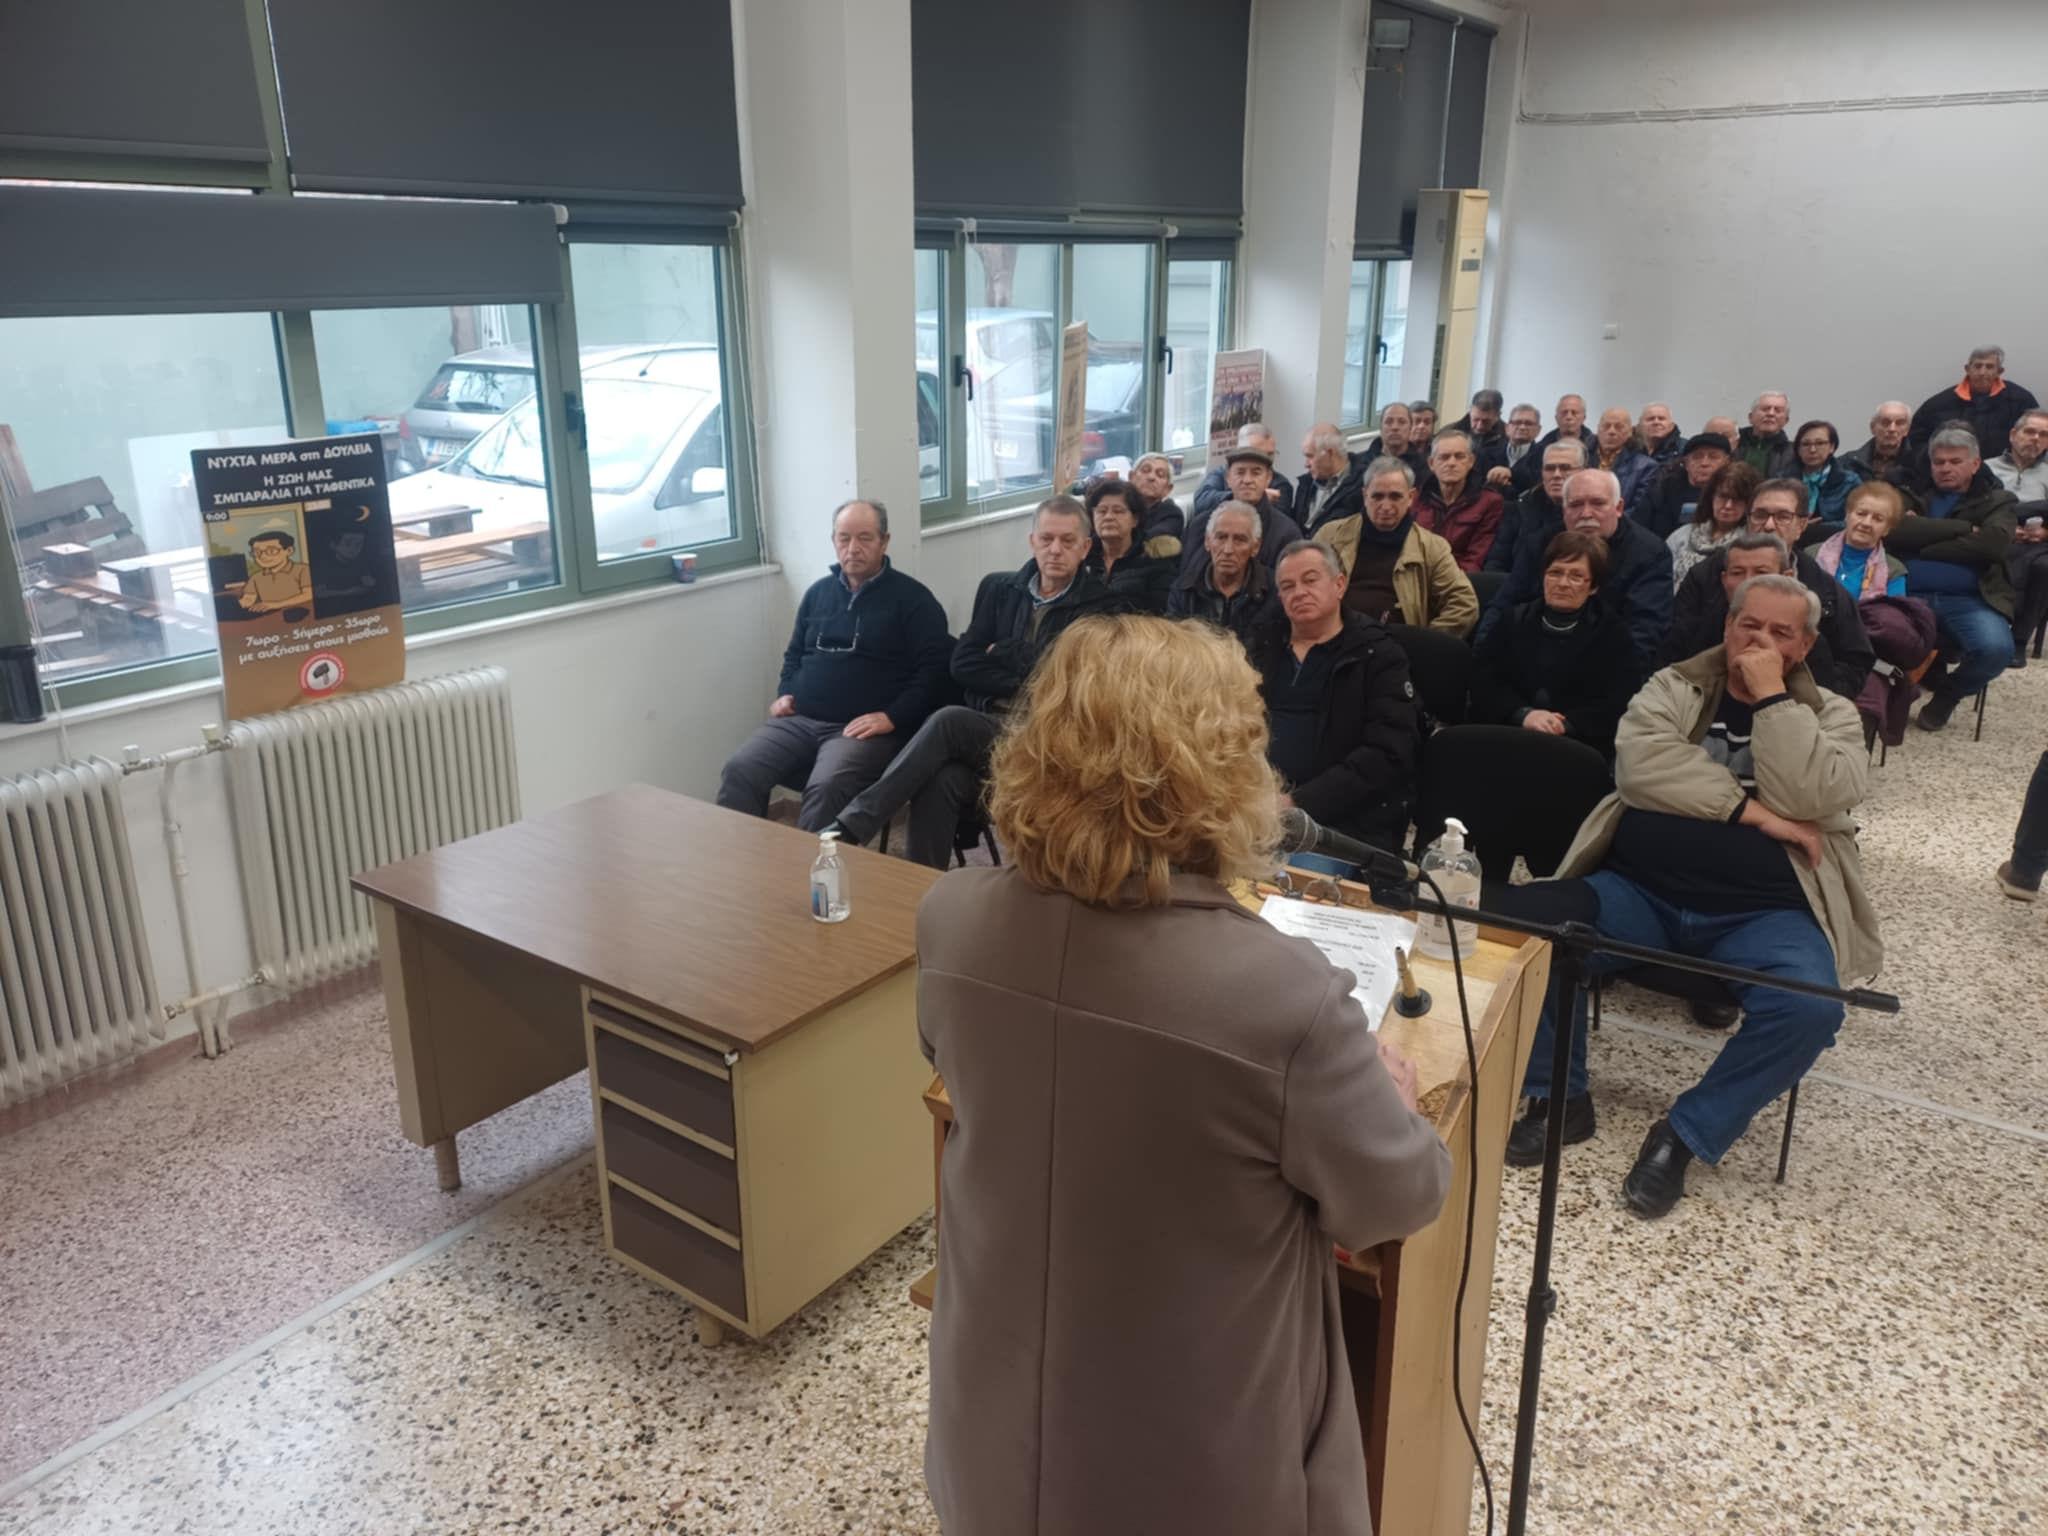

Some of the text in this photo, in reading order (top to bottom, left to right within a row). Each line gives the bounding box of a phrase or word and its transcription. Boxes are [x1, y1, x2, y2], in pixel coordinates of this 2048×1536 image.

[207, 443, 373, 470] ΝΥΧΤΑ ΜΕΡΑ στη ΔΟΥΛΕΙΑ
[264, 469, 333, 487] Η ΖΩΗ ΜΑΣ
[213, 487, 292, 505] ΣΜΠΑΡΑΛΙΑ
[295, 485, 312, 497] ΓΙΑ
[245, 635, 280, 647] 7ωρο
[344, 614, 381, 629] 35ωρο
[239, 652, 254, 665] με
